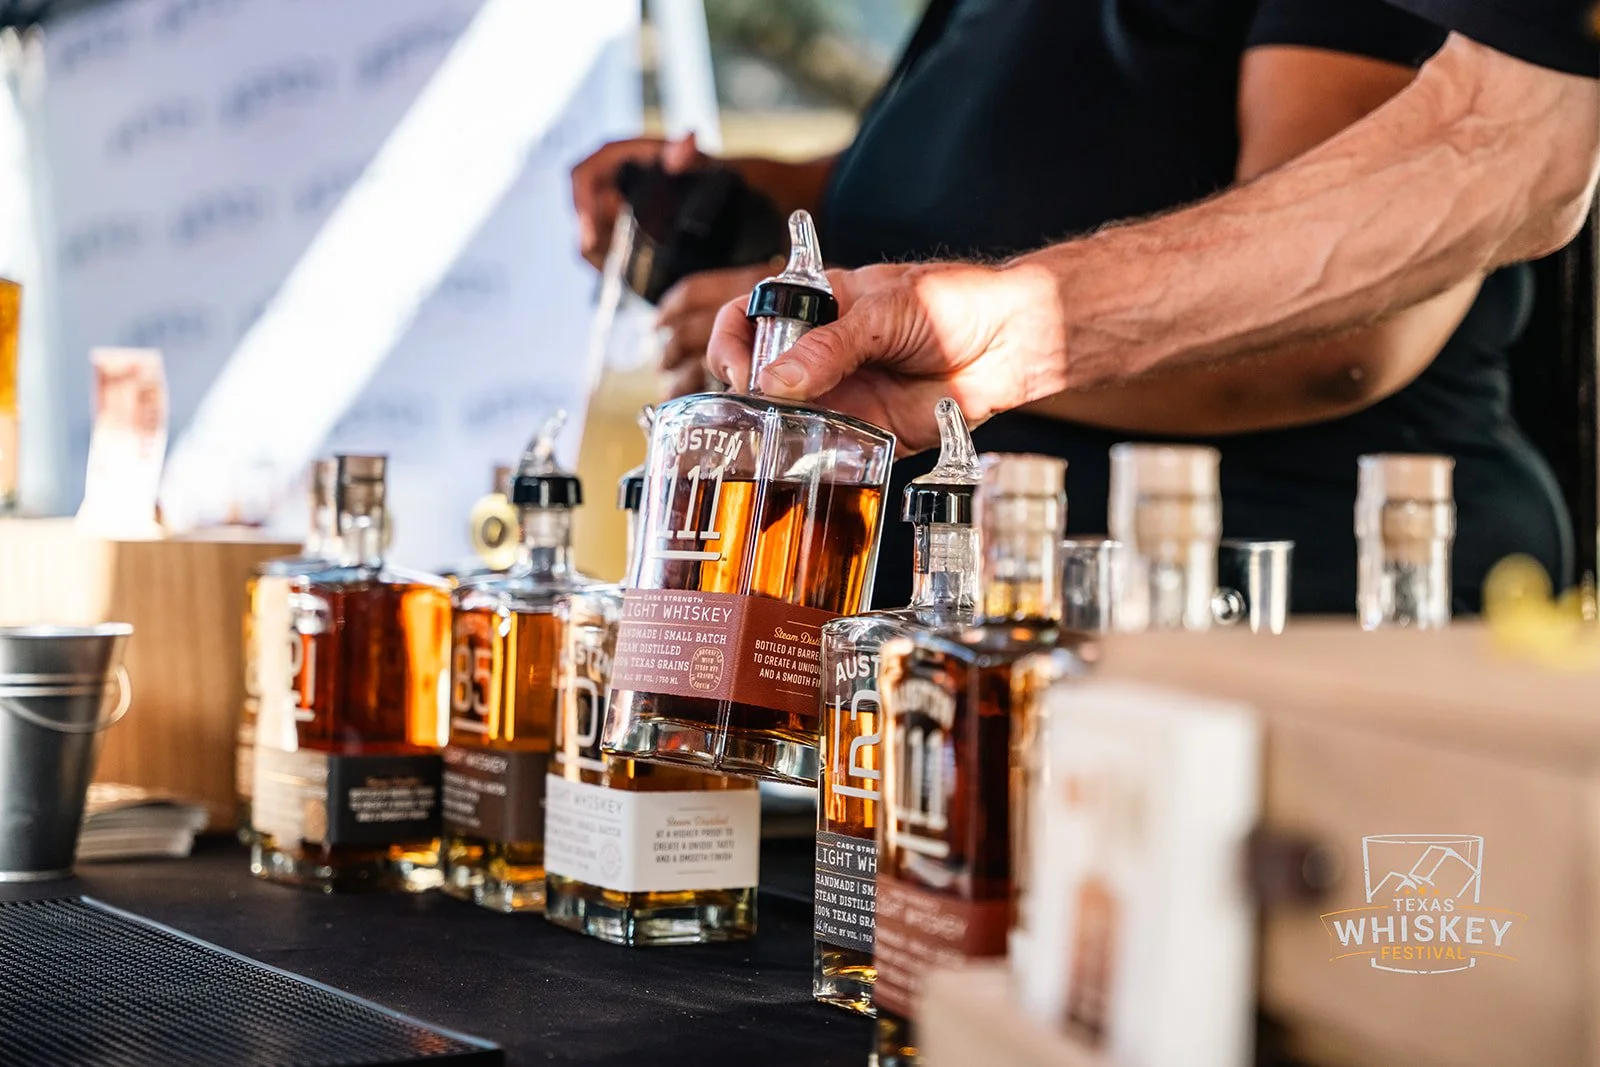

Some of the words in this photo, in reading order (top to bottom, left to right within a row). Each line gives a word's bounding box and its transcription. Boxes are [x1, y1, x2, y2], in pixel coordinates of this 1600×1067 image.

[664, 595, 704, 604] STRENGTH
[663, 604, 733, 623] WHISKEY
[622, 628, 657, 639] ANDMADE
[664, 630, 692, 642] SMALL
[695, 633, 727, 645] BATCH
[774, 627, 800, 642] Steam
[619, 642, 638, 653] TEAM
[640, 643, 682, 656] DISTILLED
[755, 639, 787, 655] BOTTLED
[787, 646, 796, 656] AT
[631, 658, 655, 669] TEXAS
[657, 660, 690, 672] GRAINS
[753, 652, 763, 664] TO
[764, 655, 791, 669] CREATE
[791, 661, 797, 670] A
[454, 645, 492, 715] 85
[759, 668, 775, 679] AND
[775, 671, 781, 680] A
[782, 672, 811, 686] SMOOTH
[837, 841, 855, 850] CASK
[815, 847, 852, 868] LIGHT
[857, 855, 877, 873] WH
[815, 873, 855, 892] HANDMADE
[815, 889, 837, 904] STEAM
[815, 904, 830, 918] 100%
[832, 909, 857, 924] TEXAS
[860, 915, 877, 928] GRA
